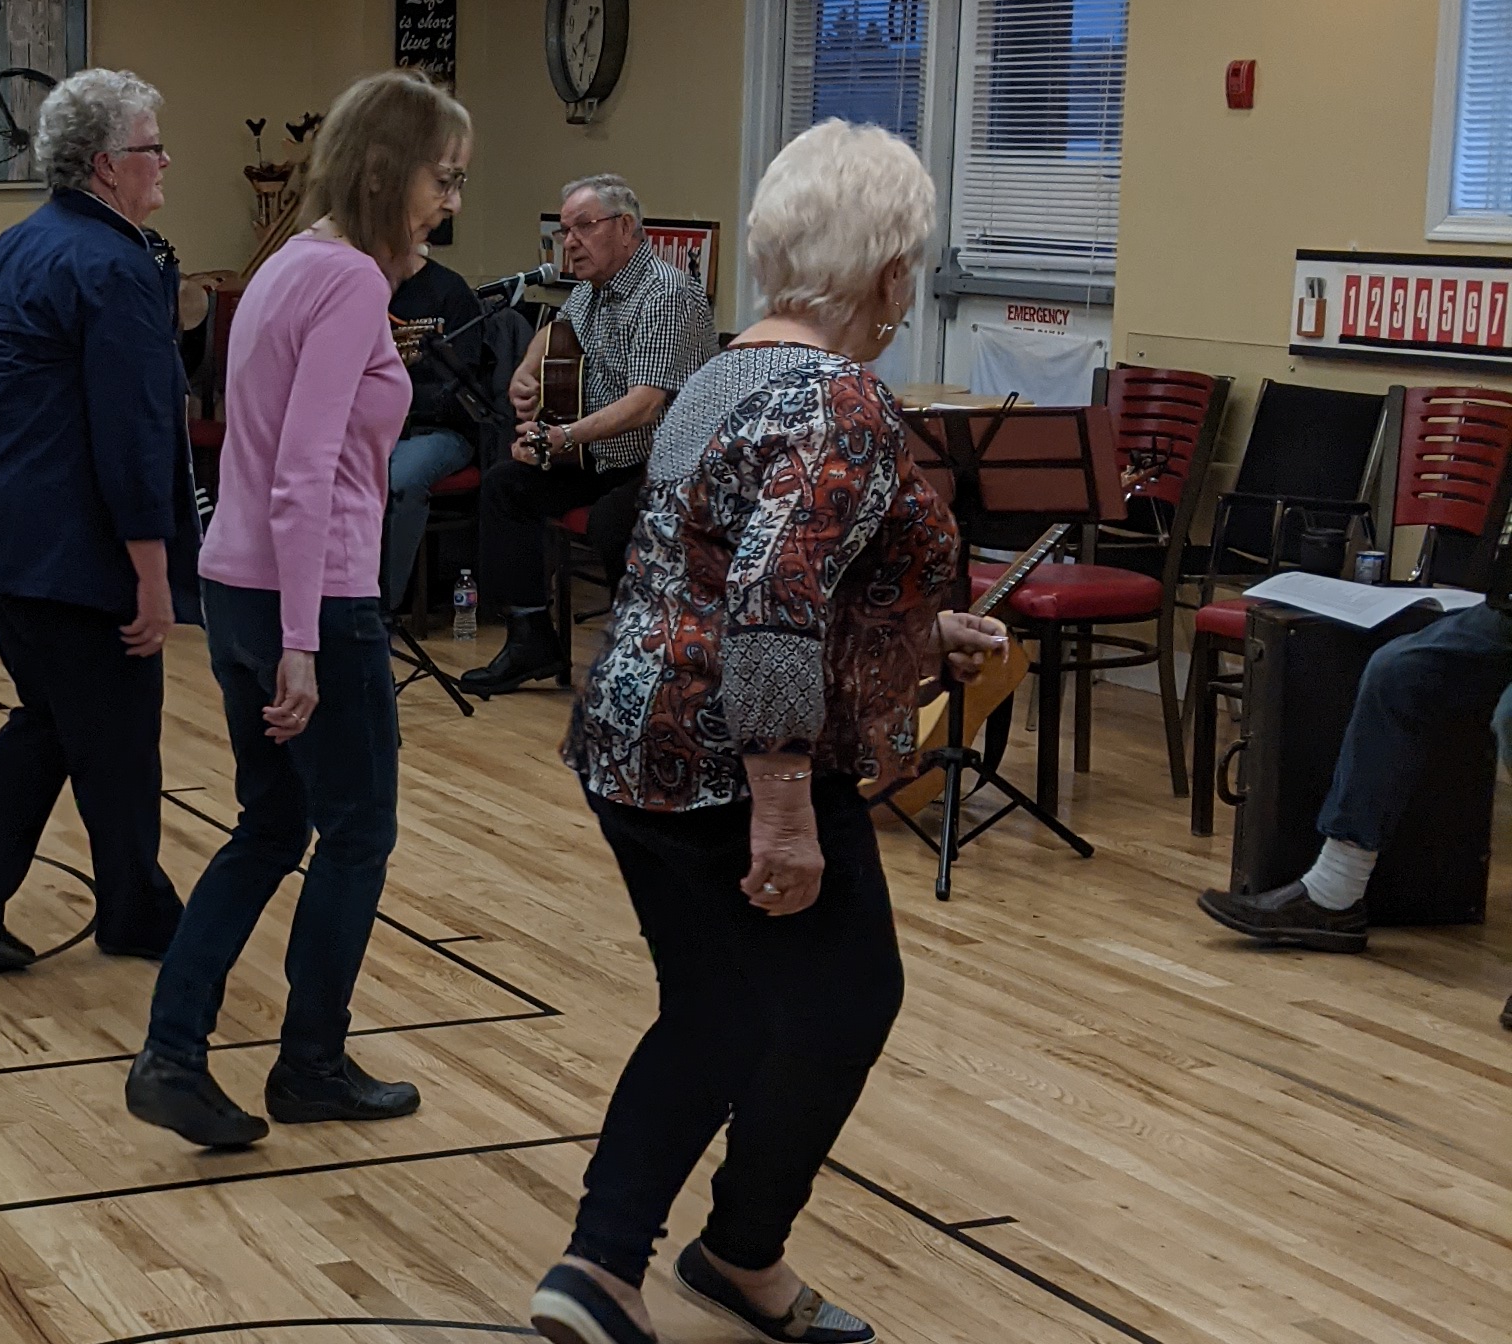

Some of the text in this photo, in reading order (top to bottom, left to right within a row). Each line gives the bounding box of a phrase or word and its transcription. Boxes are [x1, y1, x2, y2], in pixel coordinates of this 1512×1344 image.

[400, 11, 454, 29] is short
[400, 31, 453, 50] live it
[1007, 304, 1070, 326] EMERGENCY
[1348, 286, 1504, 335] 1 2 3 4 5 6 7
